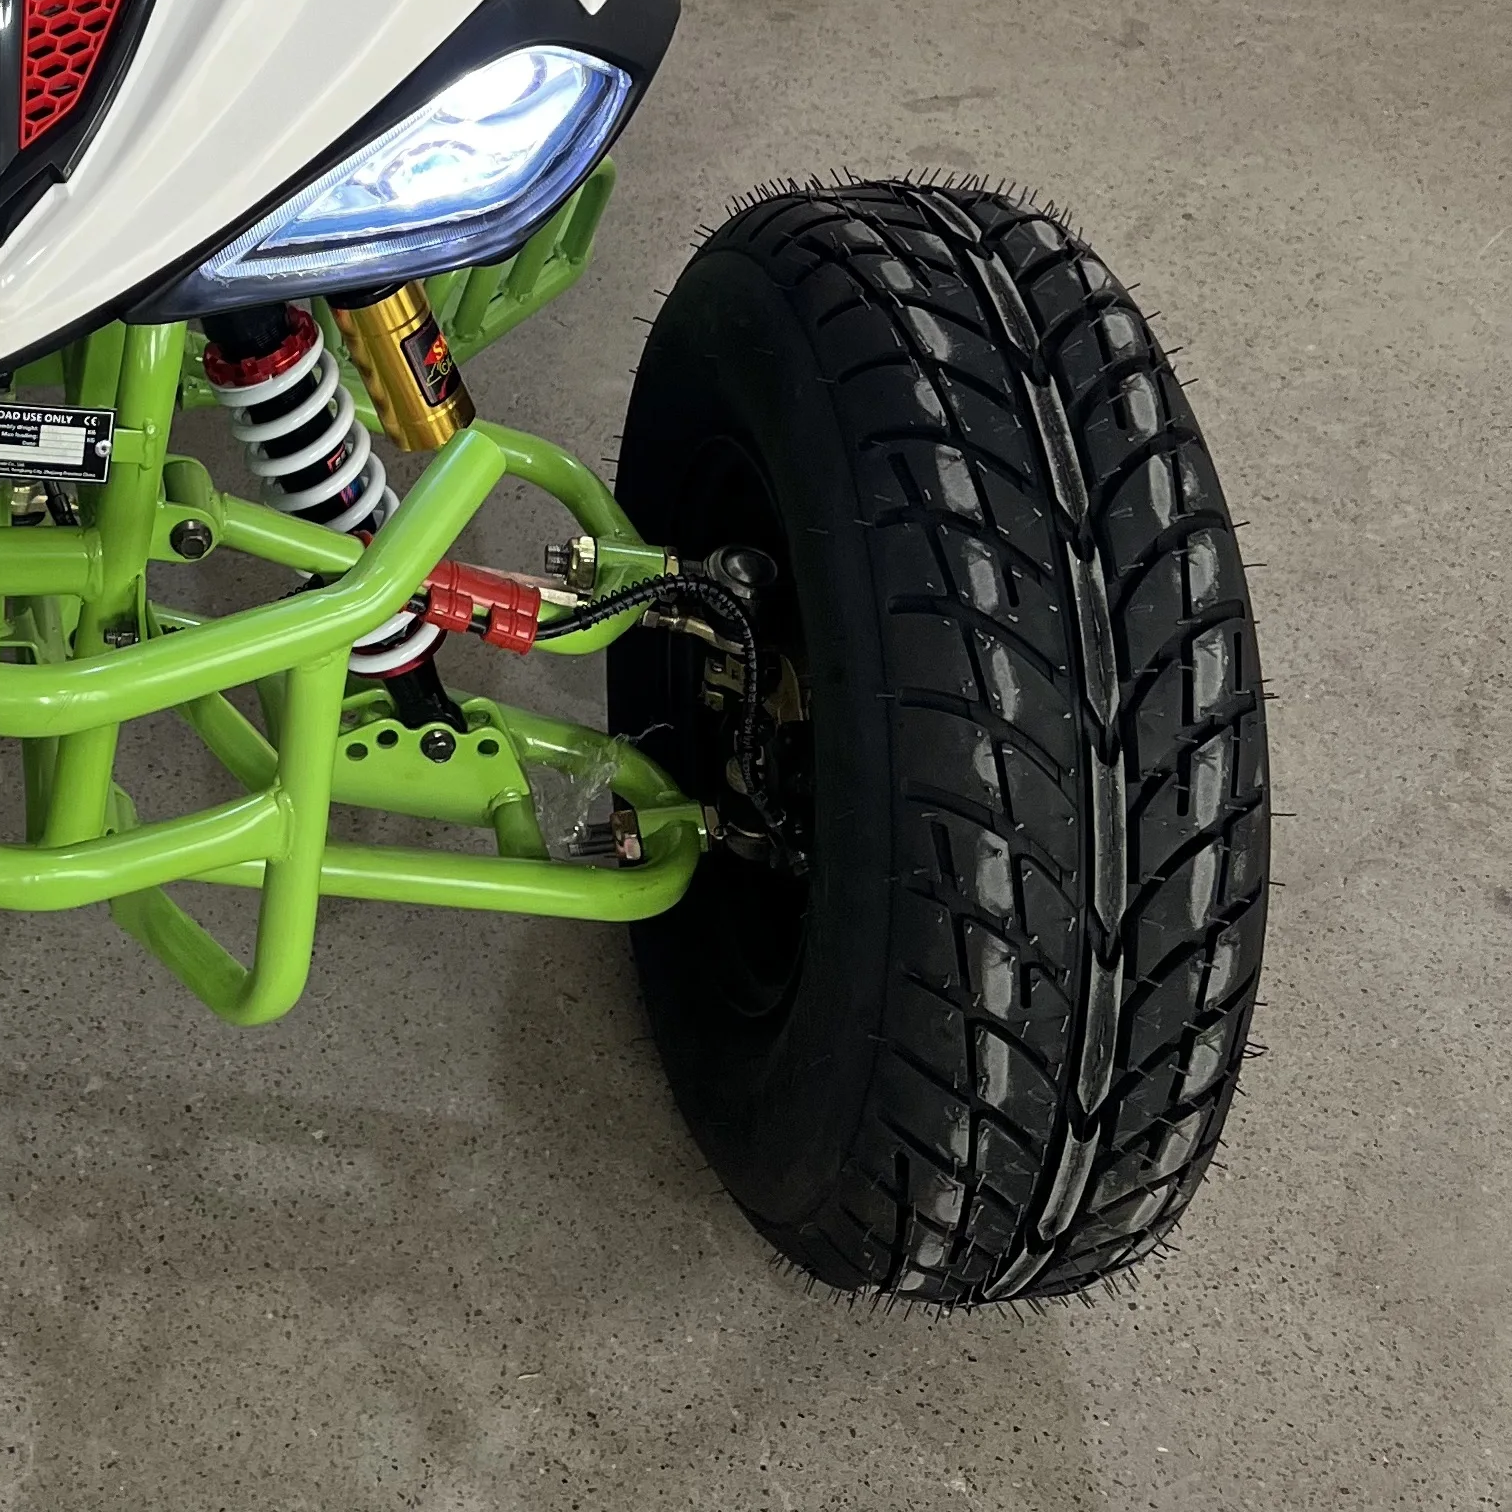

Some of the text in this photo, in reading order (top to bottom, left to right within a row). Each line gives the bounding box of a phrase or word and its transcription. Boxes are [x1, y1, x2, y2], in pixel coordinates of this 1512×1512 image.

[23, 411, 43, 422] USE
[44, 413, 73, 424] ONLY
[83, 415, 98, 426] CE
